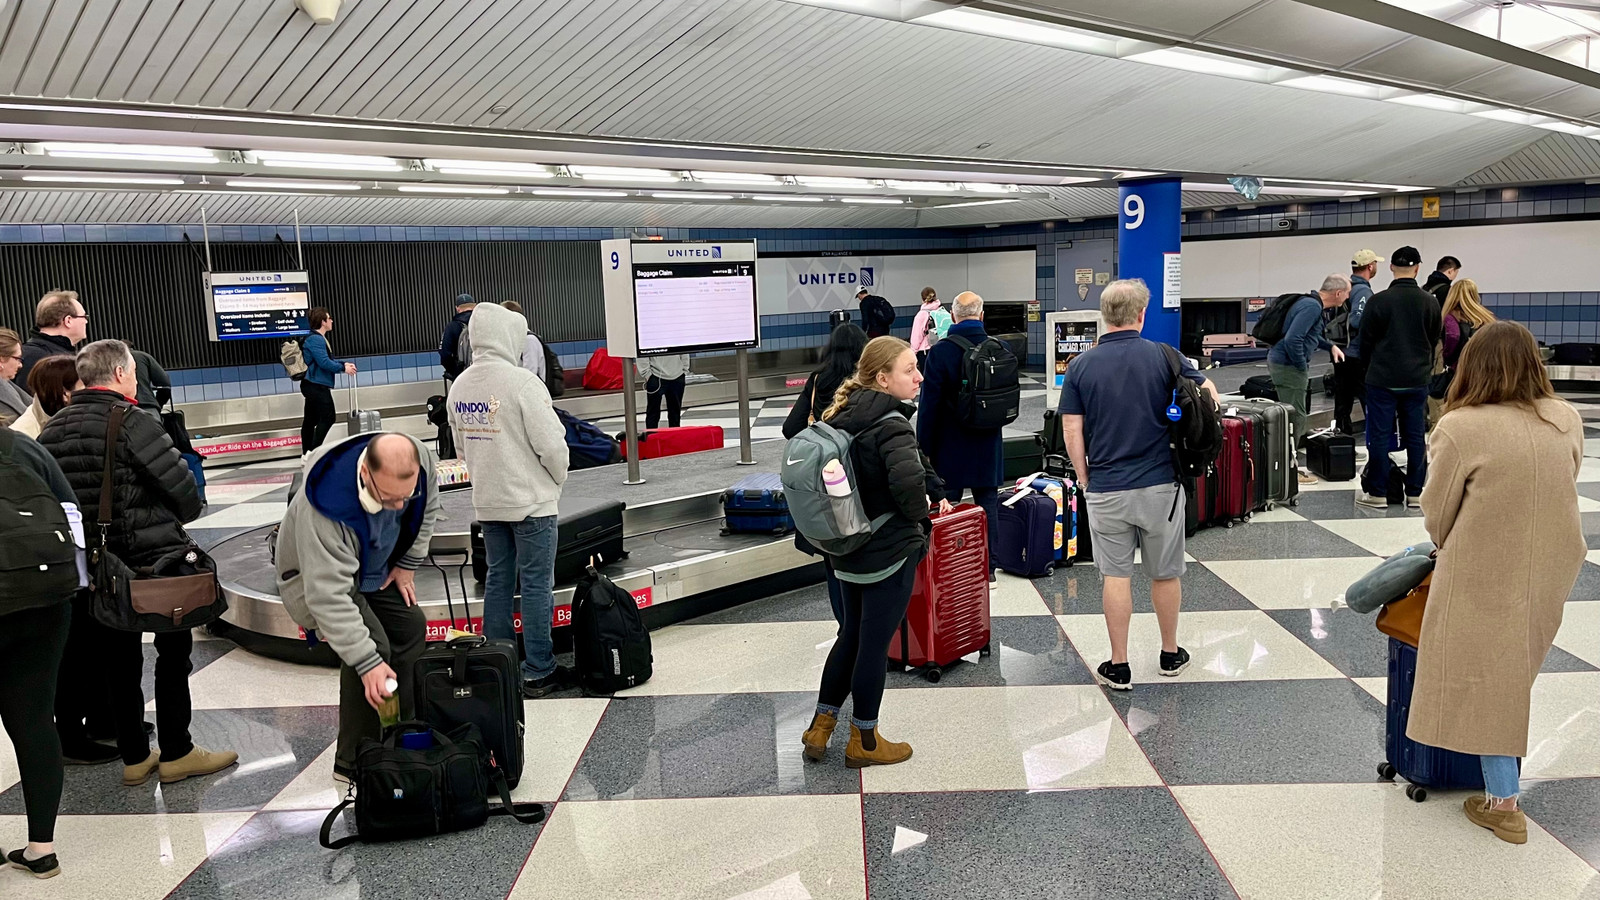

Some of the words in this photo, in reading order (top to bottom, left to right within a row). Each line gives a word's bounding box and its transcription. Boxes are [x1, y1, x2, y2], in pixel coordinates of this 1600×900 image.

[1123, 194, 1145, 230] 9
[668, 249, 710, 257] UNITED
[610, 251, 620, 270] 9
[636, 270, 659, 278] Baggage
[798, 272, 857, 285] UNITED
[1057, 342, 1079, 352] CHICAGO
[460, 413, 488, 425] GENIE
[198, 446, 219, 454] Stand,
[227, 443, 241, 451] Ride
[251, 440, 262, 448] the
[262, 438, 287, 447] Baggage
